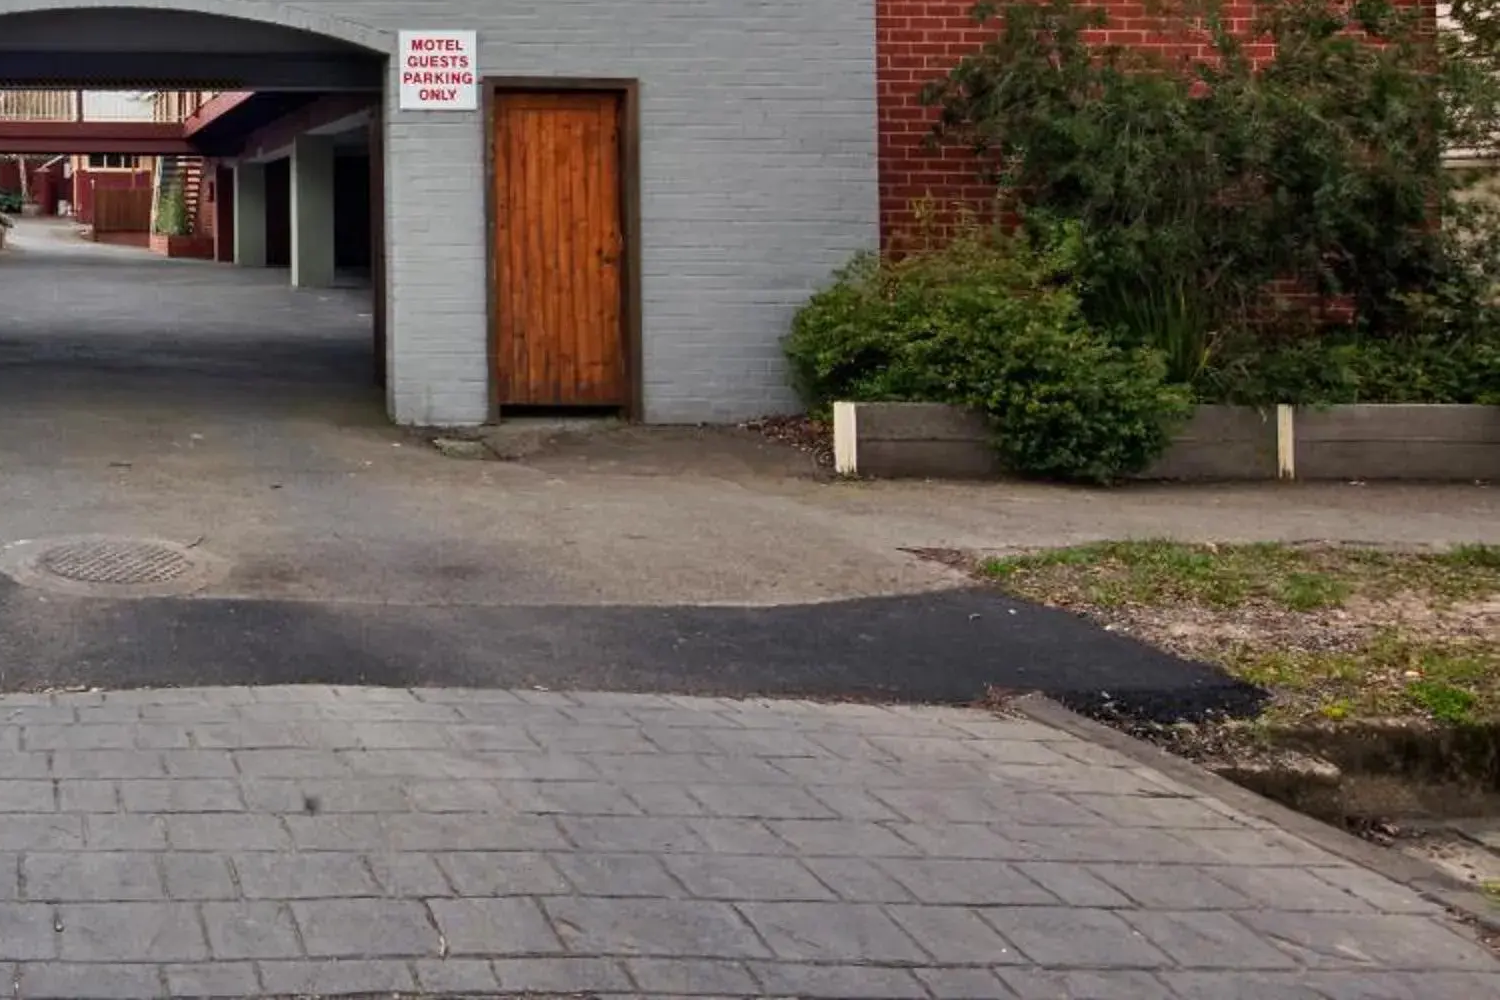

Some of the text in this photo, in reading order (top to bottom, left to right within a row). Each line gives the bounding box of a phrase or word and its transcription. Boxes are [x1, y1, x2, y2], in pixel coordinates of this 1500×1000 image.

[411, 39, 463, 51] MOTEL
[407, 56, 469, 68] GUESTS
[403, 72, 473, 85] PARKING
[419, 89, 457, 101] ONLY
